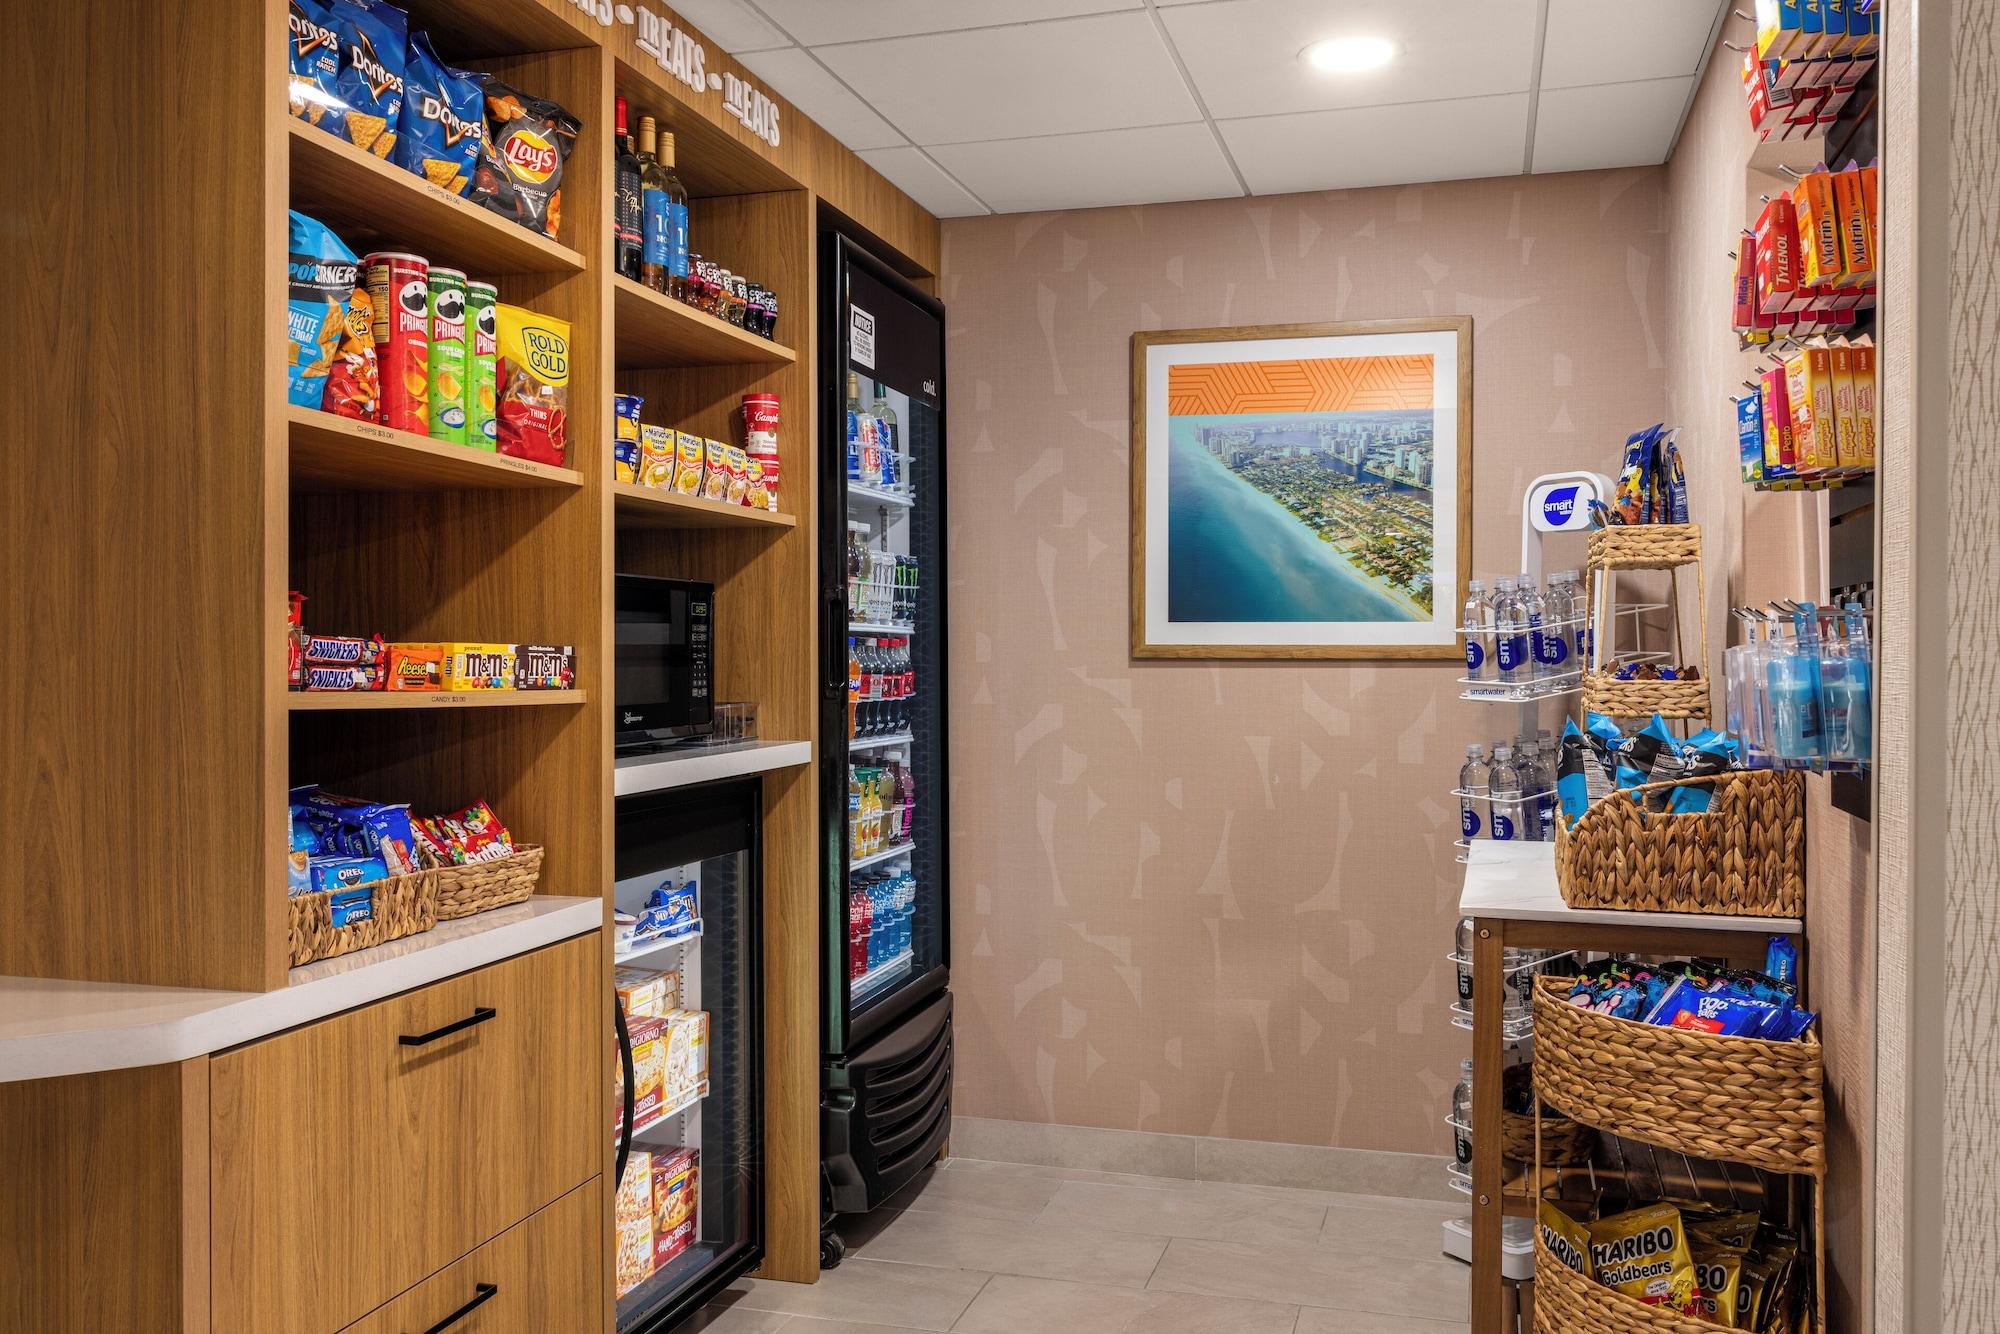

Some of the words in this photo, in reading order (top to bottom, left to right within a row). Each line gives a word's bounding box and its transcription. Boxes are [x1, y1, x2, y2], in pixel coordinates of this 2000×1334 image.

[635, 5, 706, 93] TREATS
[352, 45, 404, 98] Doritos
[722, 71, 781, 147] TREATS
[508, 138, 554, 172] Lay's
[1821, 219, 1836, 266] Motrin
[1851, 218, 1867, 264] Motrin
[1776, 234, 1790, 285] TYLENOL
[854, 313, 872, 335] NOTICE
[528, 332, 565, 354] ROLD
[531, 350, 566, 373] GOLD
[523, 419, 548, 430] ORIGINAL
[529, 408, 548, 420] THINS
[356, 425, 377, 436] CHIPS
[377, 430, 394, 440] $3.00
[1783, 425, 1793, 452] Pepto
[1544, 498, 1573, 512] smart
[308, 640, 359, 660] SNICKERS
[1470, 688, 1506, 696] smartwater
[338, 868, 365, 881] OREO
[345, 909, 371, 923] OREO
[1592, 1224, 1675, 1267] HARIBO
[1601, 1260, 1673, 1288] Goldbears
